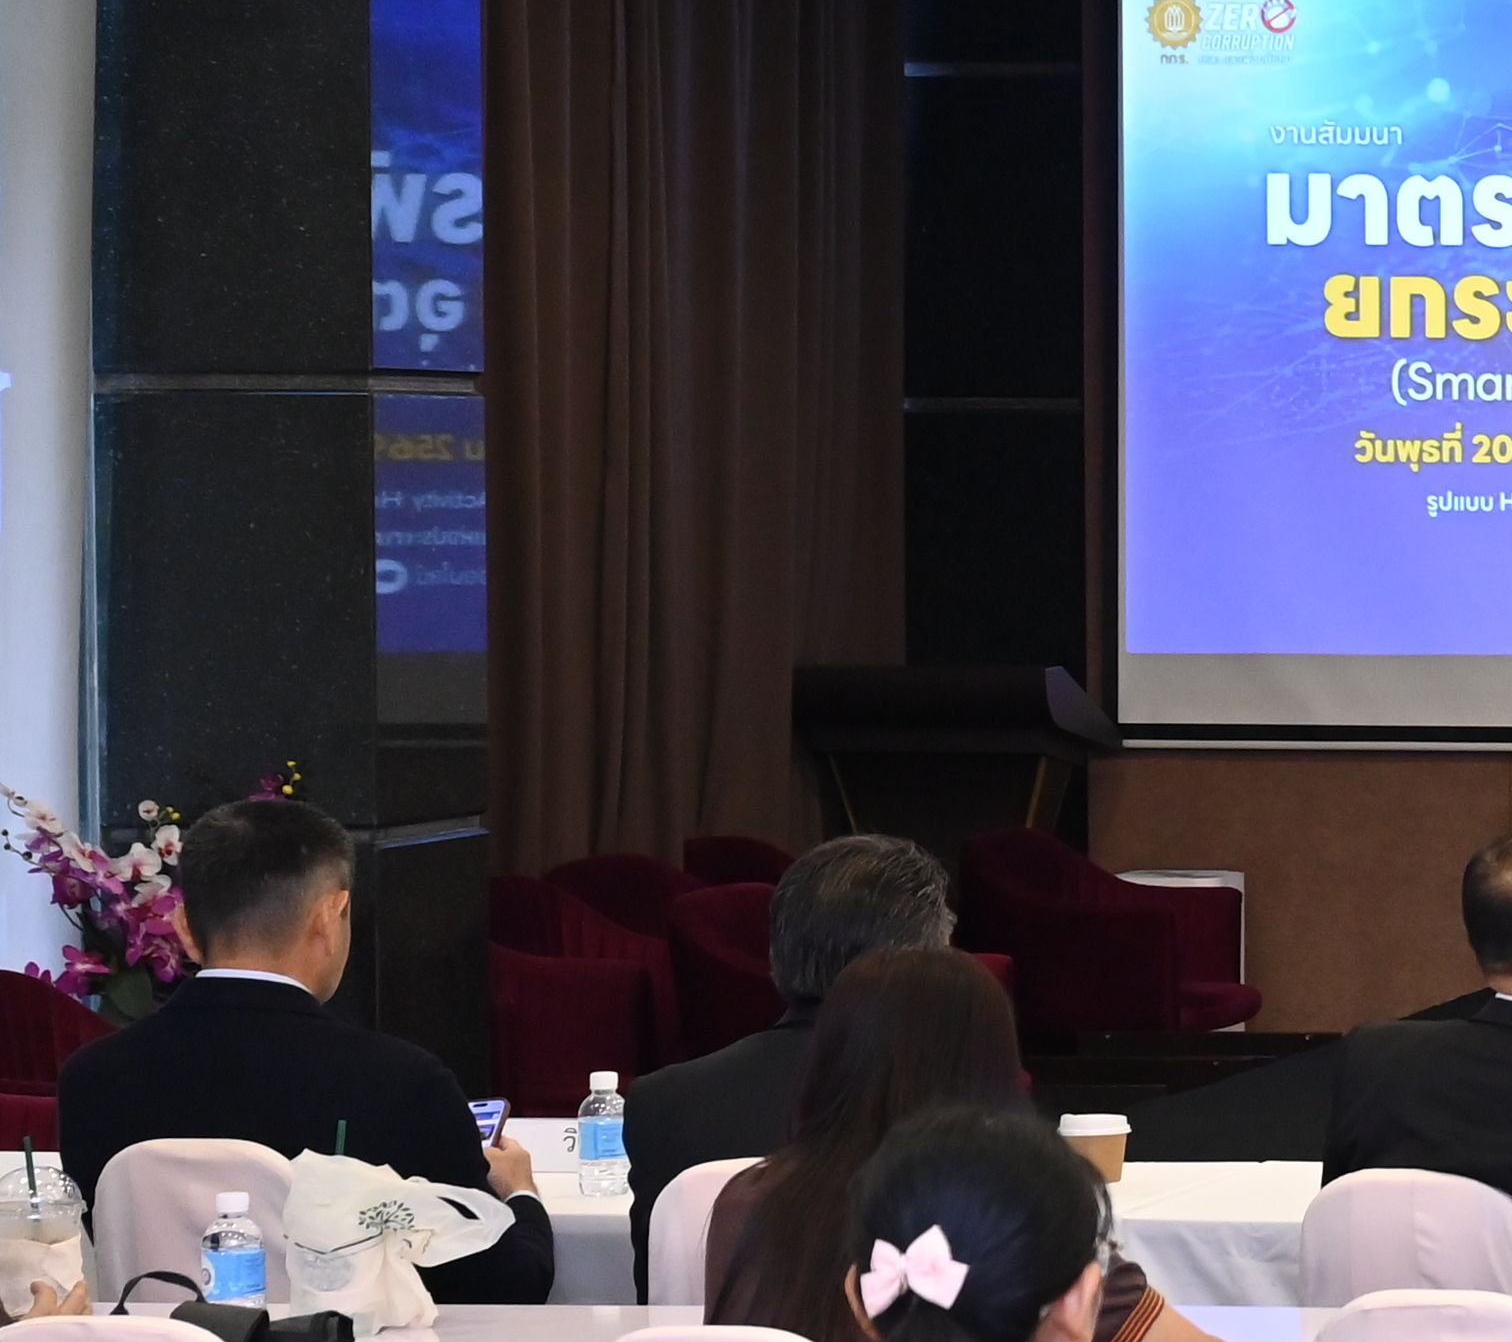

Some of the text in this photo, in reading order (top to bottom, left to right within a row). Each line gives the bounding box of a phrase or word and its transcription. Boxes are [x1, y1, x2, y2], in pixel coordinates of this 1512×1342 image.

[1201, 34, 1295, 51] CORRUPTION
[1271, 120, 1402, 146] งานสัมมนา
[1354, 422, 1463, 472] วันพุธที่
[1427, 491, 1494, 518] รูปแบบ
